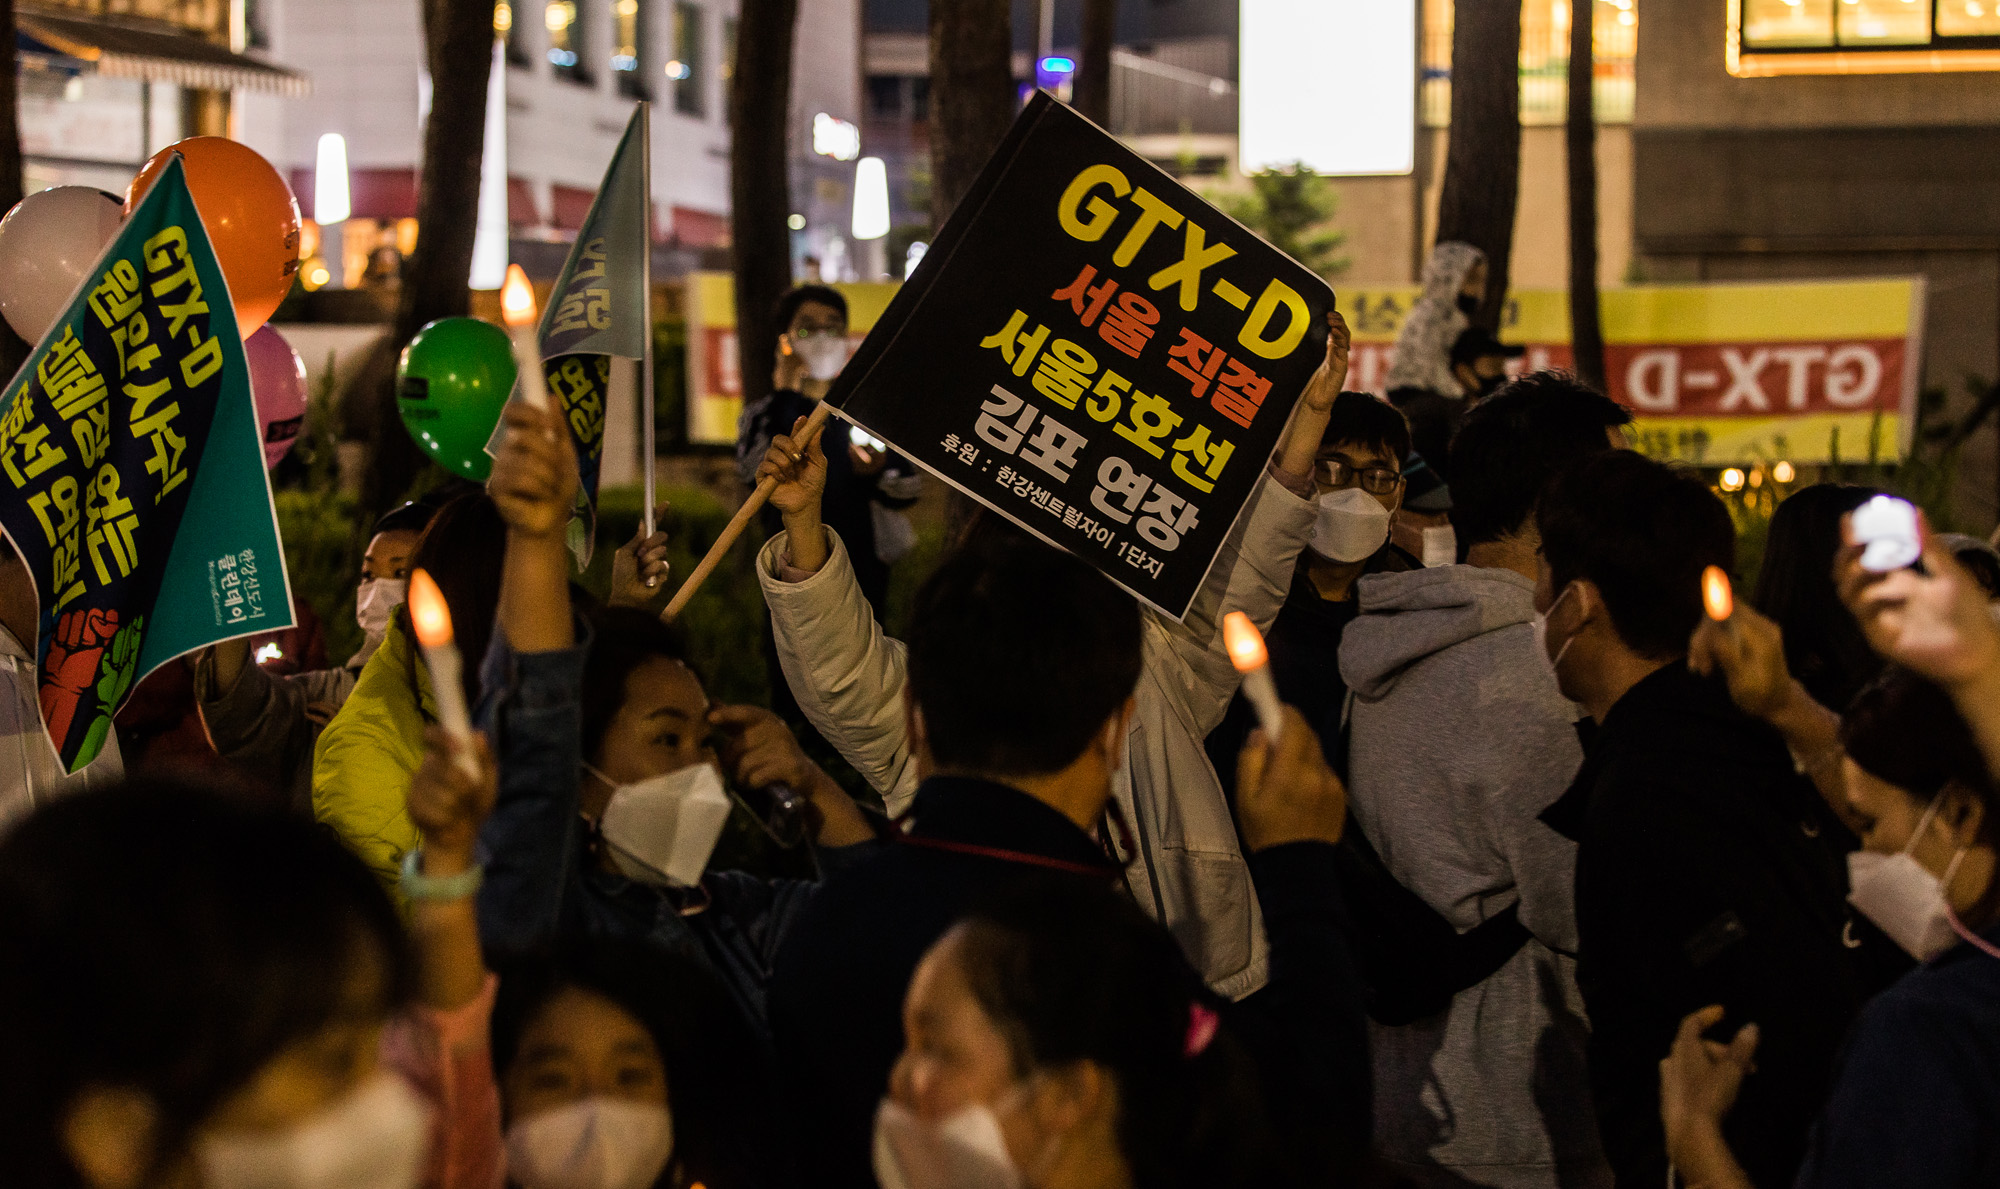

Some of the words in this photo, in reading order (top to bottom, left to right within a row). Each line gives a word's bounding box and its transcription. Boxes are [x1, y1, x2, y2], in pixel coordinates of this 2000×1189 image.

[88, 259, 161, 380] 원안
[143, 225, 223, 388] GTX-D
[1057, 164, 1310, 359] GTX-D
[980, 309, 1236, 494] 서울5호선
[1051, 264, 1160, 359] 서울
[1167, 326, 1273, 429] 직결
[37, 323, 110, 469] 건폐장
[85, 463, 140, 586] 없는
[122, 377, 188, 505] 사수!
[940, 433, 980, 466] 후원
[995, 465, 1115, 549] 한강센트럴자이
[1117, 541, 1165, 580] 1단지
[974, 384, 1088, 483] 김포
[1090, 456, 1199, 551] 연장
[27, 475, 87, 617] 연장!
[218, 553, 247, 624] 클린데이
[238, 548, 266, 619] 한강신도시
